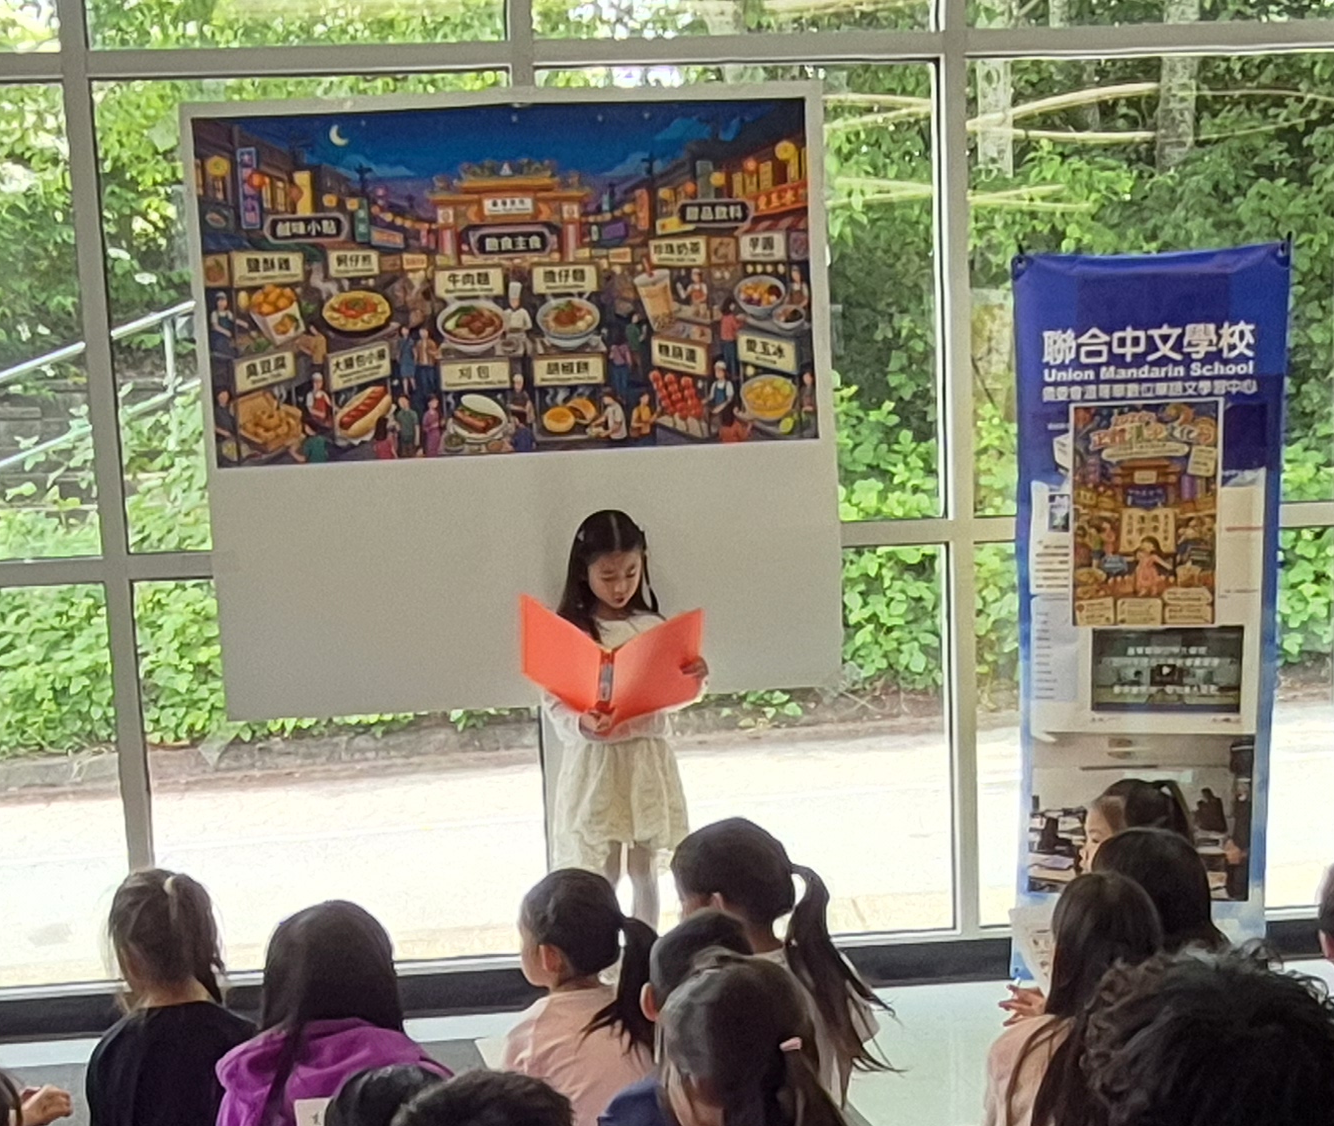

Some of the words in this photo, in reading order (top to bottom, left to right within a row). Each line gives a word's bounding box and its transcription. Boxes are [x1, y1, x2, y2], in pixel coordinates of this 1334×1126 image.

[447, 272, 490, 287] 牛肉麵
[1042, 320, 1256, 366] 聯合中文學校
[1043, 368, 1095, 382] Union
[1099, 363, 1185, 380] Mandarin
[1189, 360, 1254, 376] School
